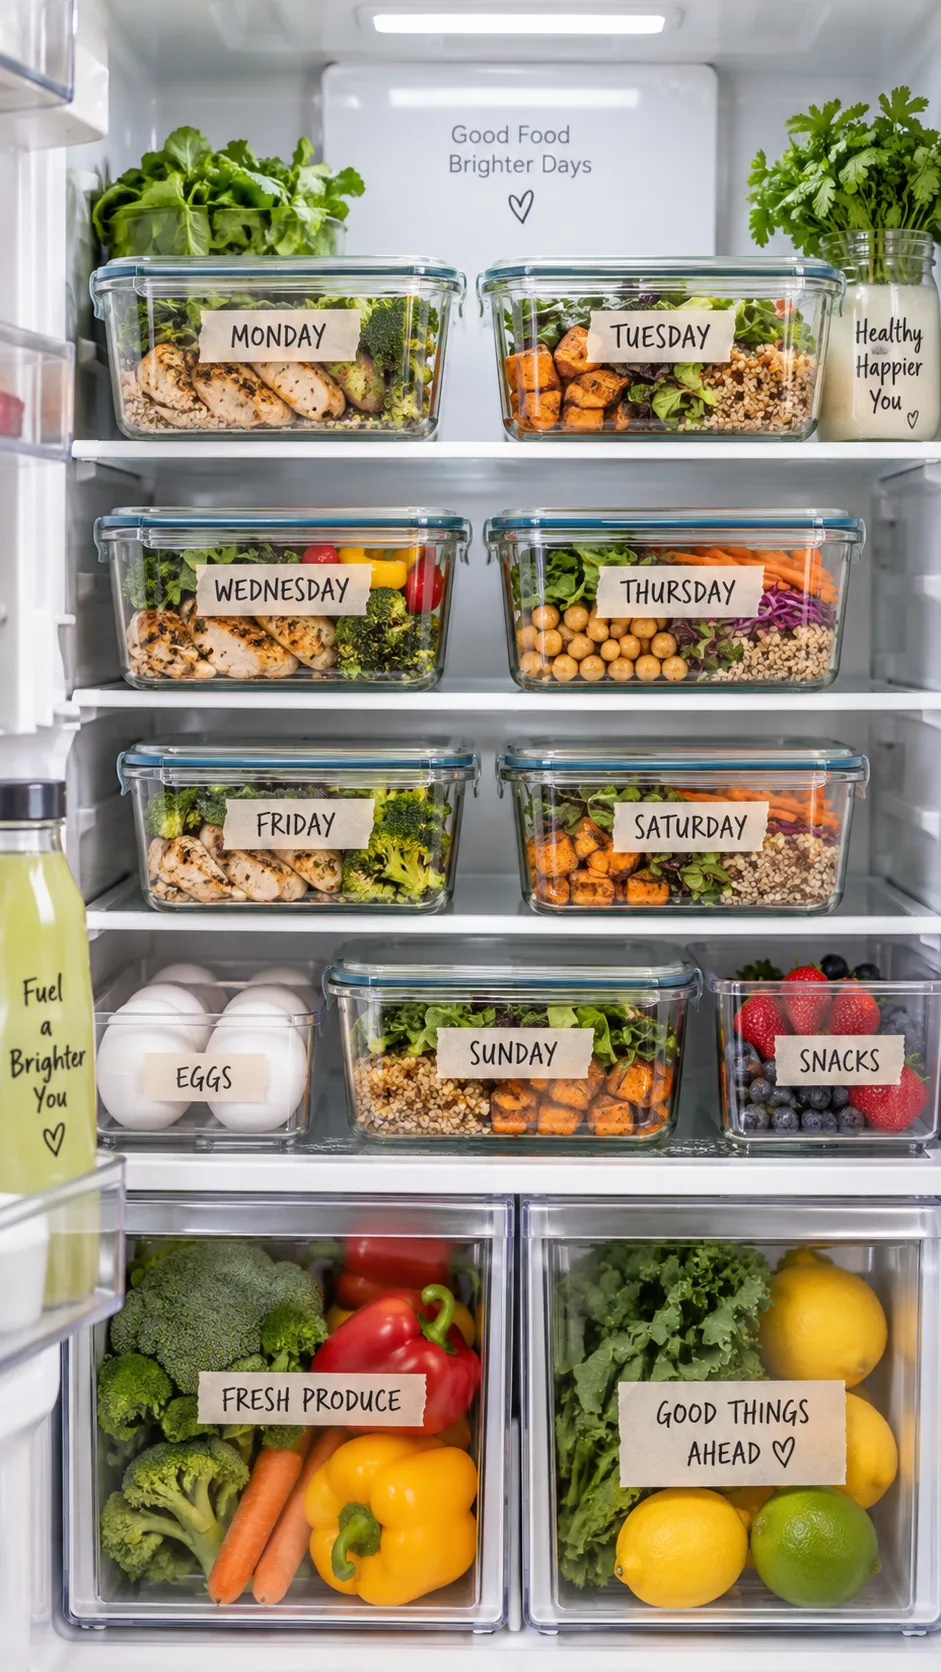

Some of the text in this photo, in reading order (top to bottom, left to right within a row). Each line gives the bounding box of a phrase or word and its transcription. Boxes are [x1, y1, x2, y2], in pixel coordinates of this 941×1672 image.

[451, 124, 570, 145] Good Food
[449, 154, 592, 179] Brighter Days
[230, 322, 327, 350] MONDAY
[609, 323, 711, 351] TUESDAY
[855, 316, 924, 354] Healthy
[856, 352, 924, 386] Happier
[869, 387, 902, 415] You
[214, 576, 350, 604] WEDNESDAY
[619, 578, 736, 606] THURSDAY
[256, 811, 336, 838] FRIDAY
[634, 813, 748, 841] SATURDAY
[22, 972, 63, 1007] Fuel
[40, 1020, 53, 1037] a
[9, 1044, 86, 1084] Brighter
[469, 1040, 558, 1067] SUNDAY
[799, 1048, 880, 1073] SNACKS
[176, 1065, 232, 1093] EGGS
[33, 1084, 68, 1114] You
[222, 1386, 402, 1413] FRESH PRODUCE
[656, 1398, 810, 1429] GOOD THINGS
[687, 1439, 761, 1467] AHEAD
